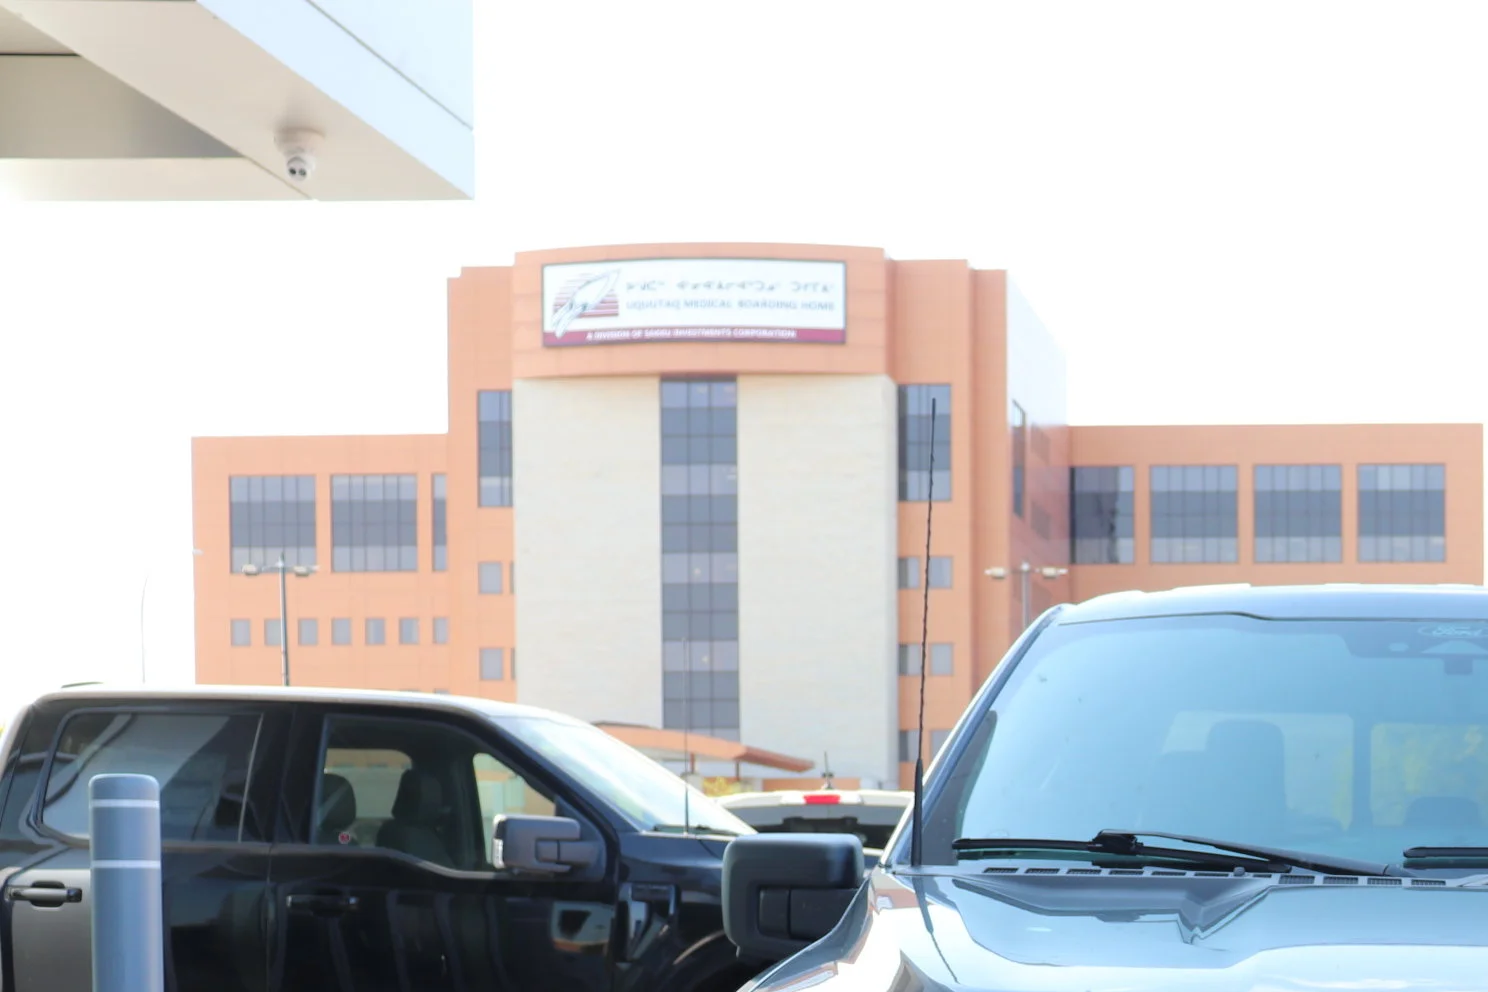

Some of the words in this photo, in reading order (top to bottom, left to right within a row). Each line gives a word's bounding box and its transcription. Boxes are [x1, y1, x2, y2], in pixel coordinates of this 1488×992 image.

[684, 299, 733, 310] MEDICAL
[737, 299, 797, 310] BOARDING
[800, 300, 835, 311] HOME
